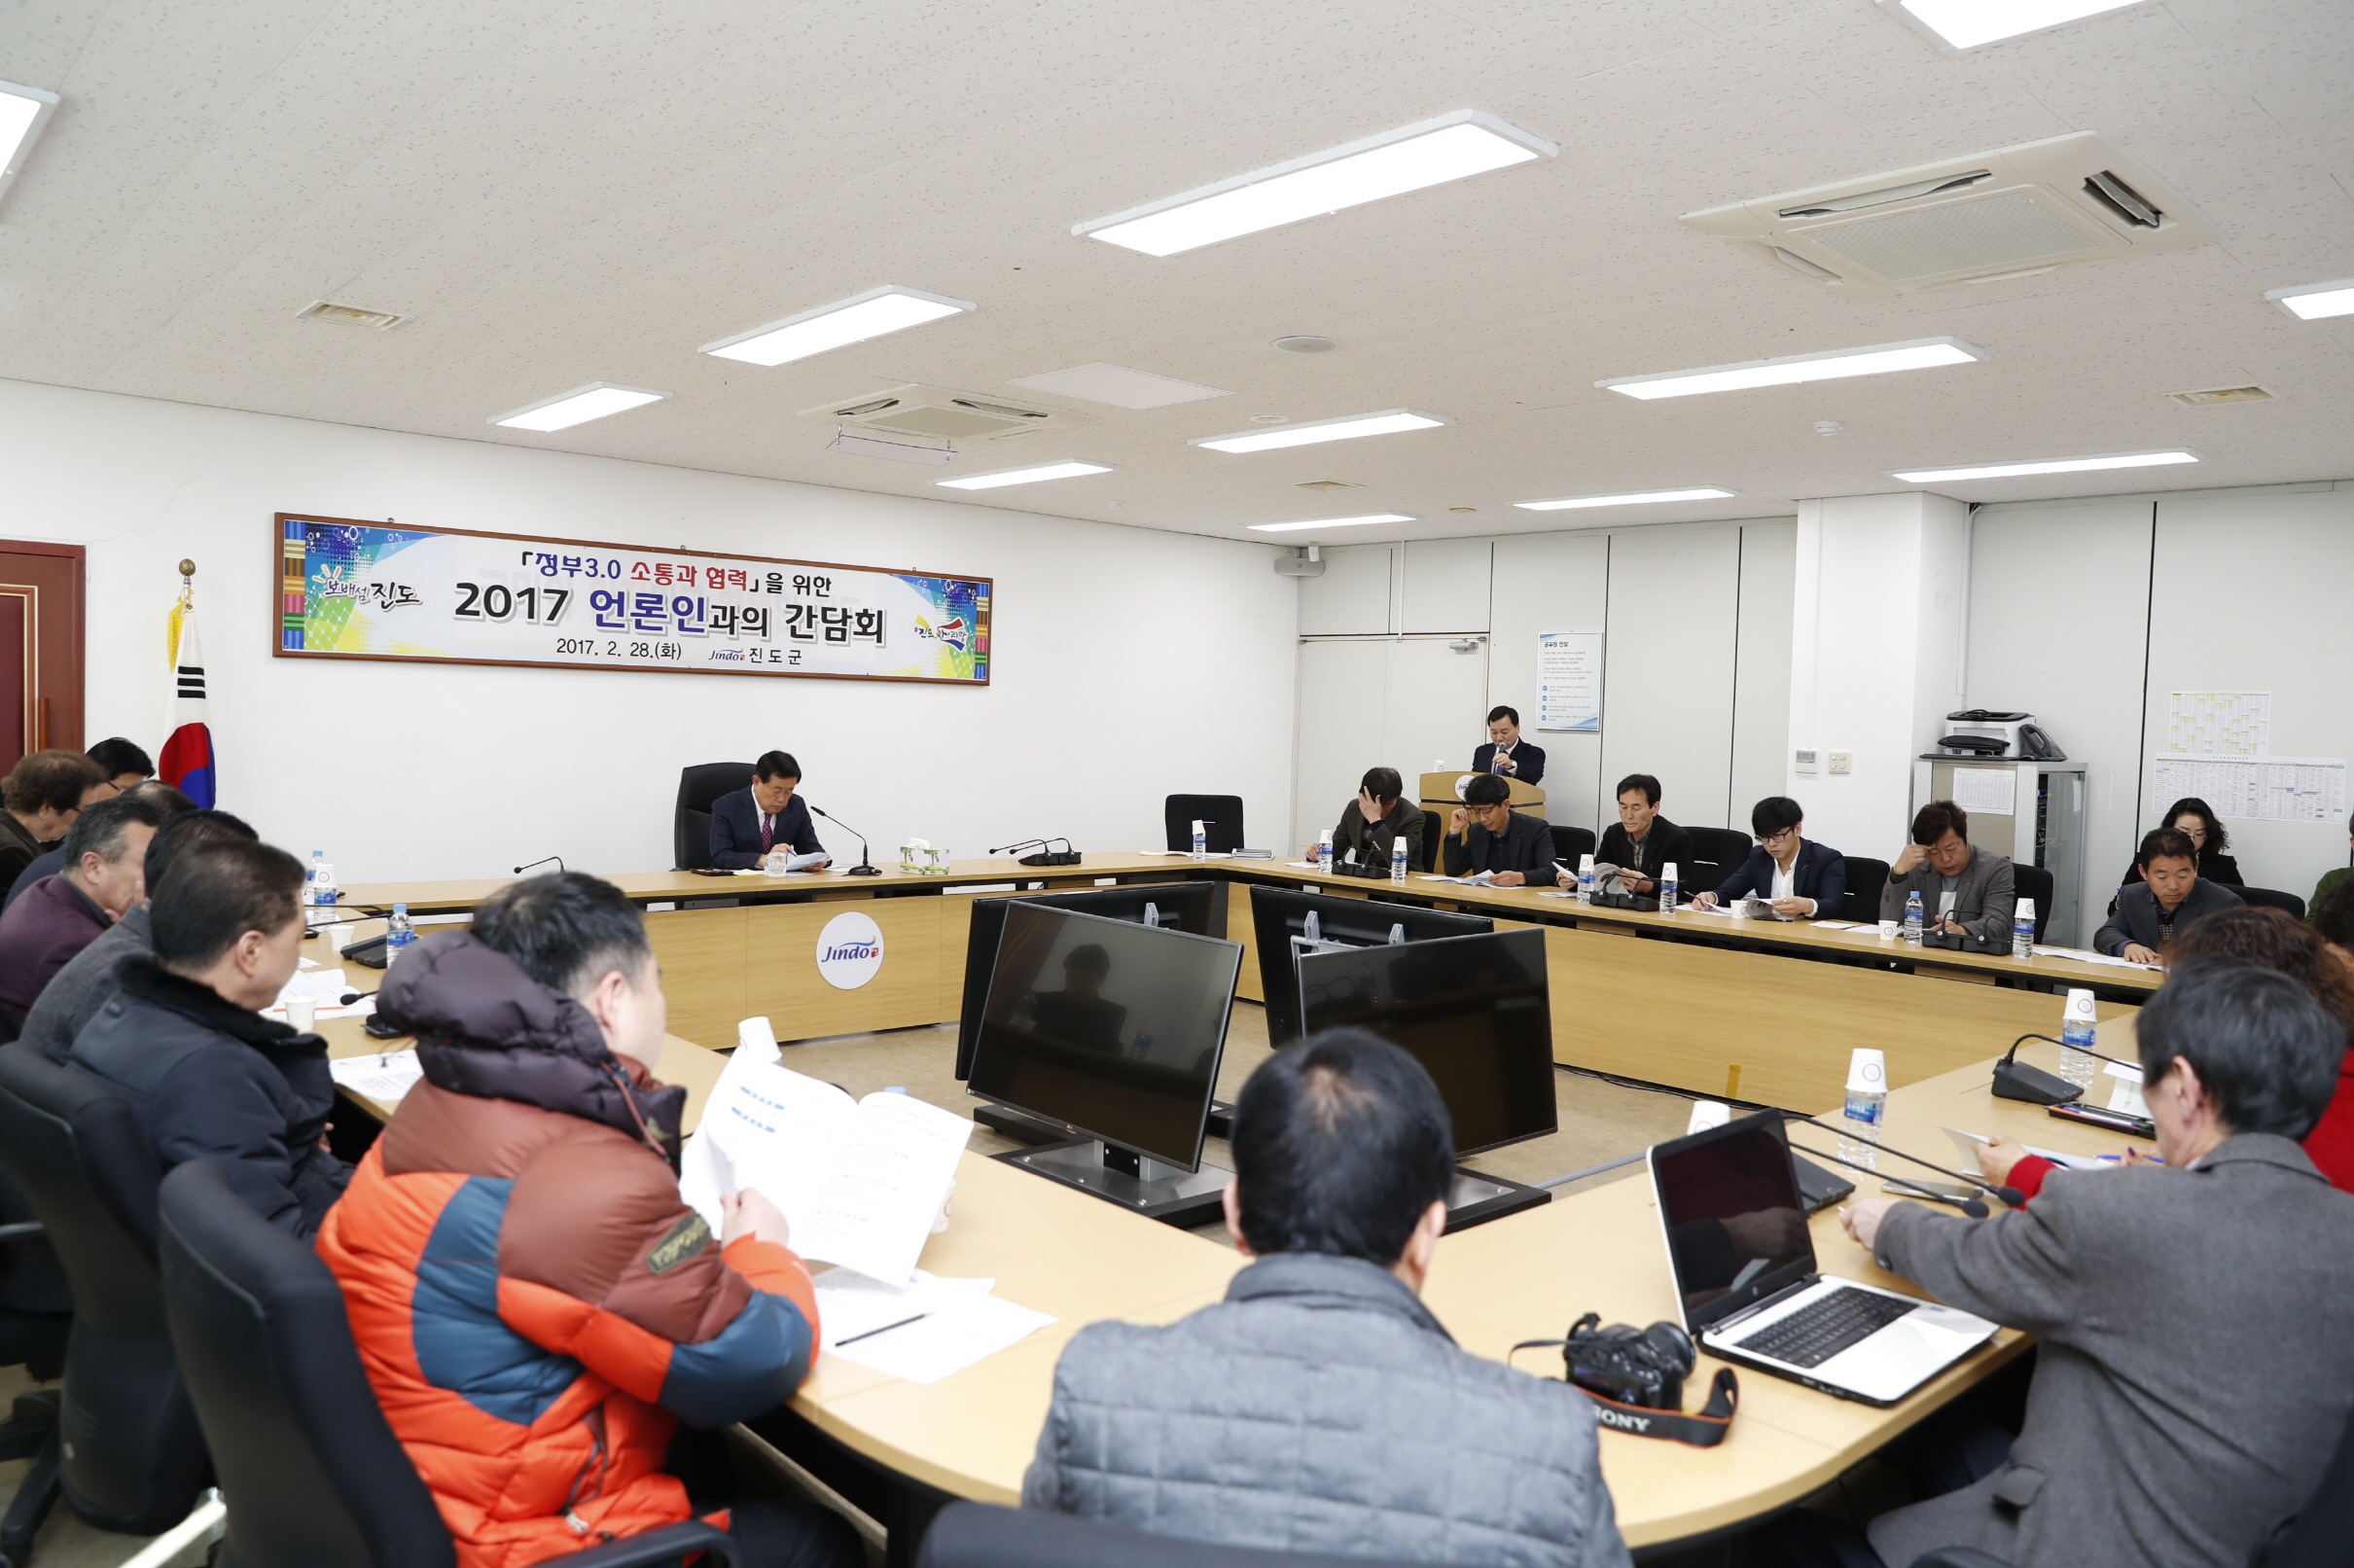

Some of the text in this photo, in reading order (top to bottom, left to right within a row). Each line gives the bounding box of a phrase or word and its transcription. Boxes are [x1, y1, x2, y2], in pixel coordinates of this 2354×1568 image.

[630, 561, 697, 588] 소통과
[792, 575, 832, 597] 위한
[325, 580, 420, 609] 보배섬 진도
[454, 582, 883, 643] 2017 언론인과의 간담회
[556, 638, 682, 660] 2017. 2. 28.(화)
[708, 649, 739, 661] Jindo
[821, 945, 870, 963] Jindo
